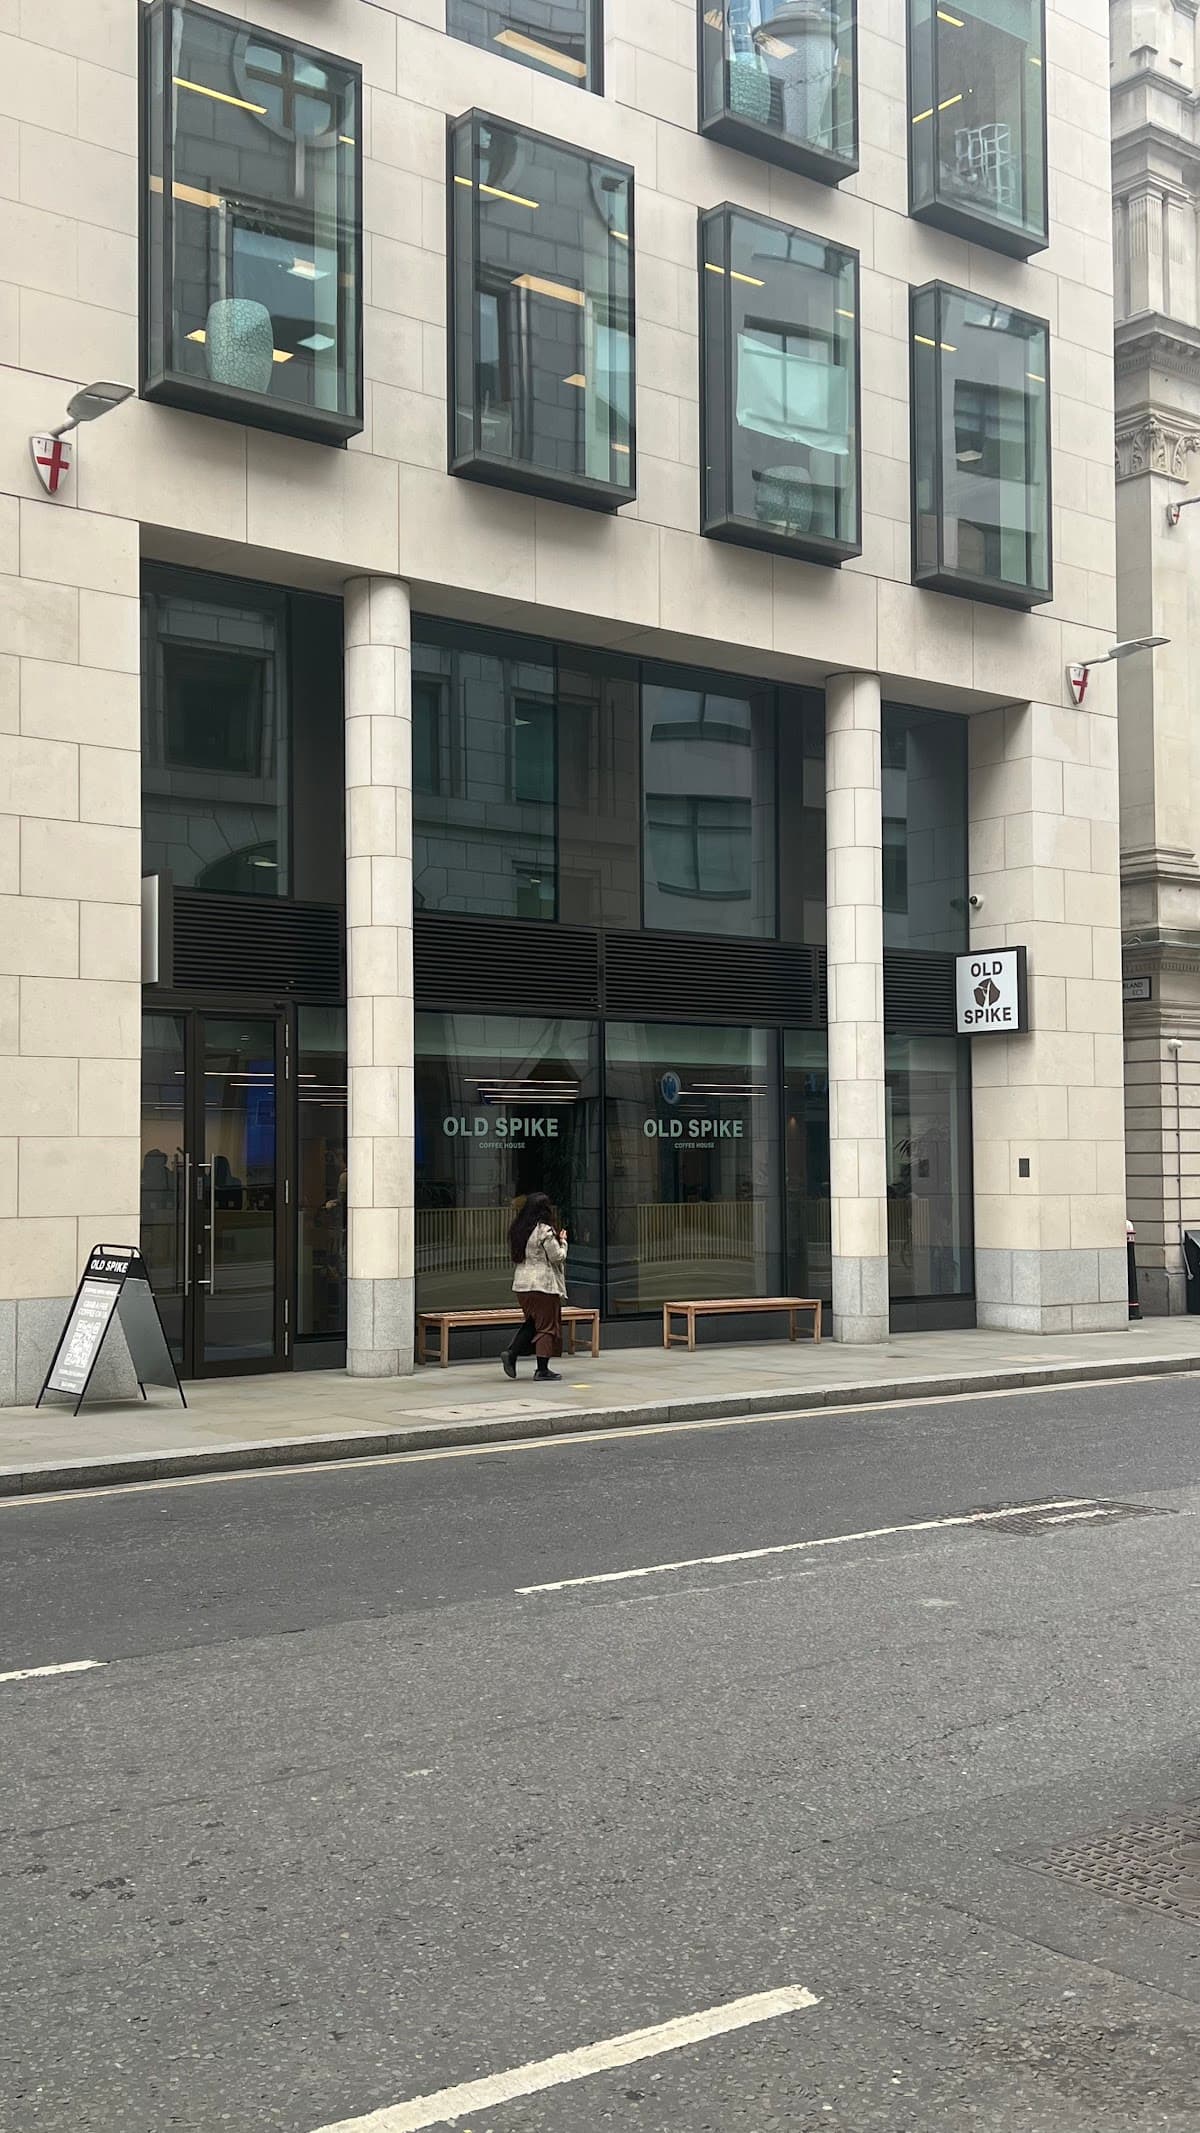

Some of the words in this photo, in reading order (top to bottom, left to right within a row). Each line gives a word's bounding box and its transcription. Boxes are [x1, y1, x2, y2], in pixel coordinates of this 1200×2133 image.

[971, 961, 1003, 977] OLD
[964, 1007, 1012, 1024] SPIKE
[443, 1116, 489, 1137] OLD
[495, 1117, 559, 1137] SPIKE
[643, 1119, 683, 1138] OLD
[688, 1119, 744, 1138] SPIKE
[91, 1259, 105, 1270] OLD
[105, 1261, 128, 1273] SPIKE
